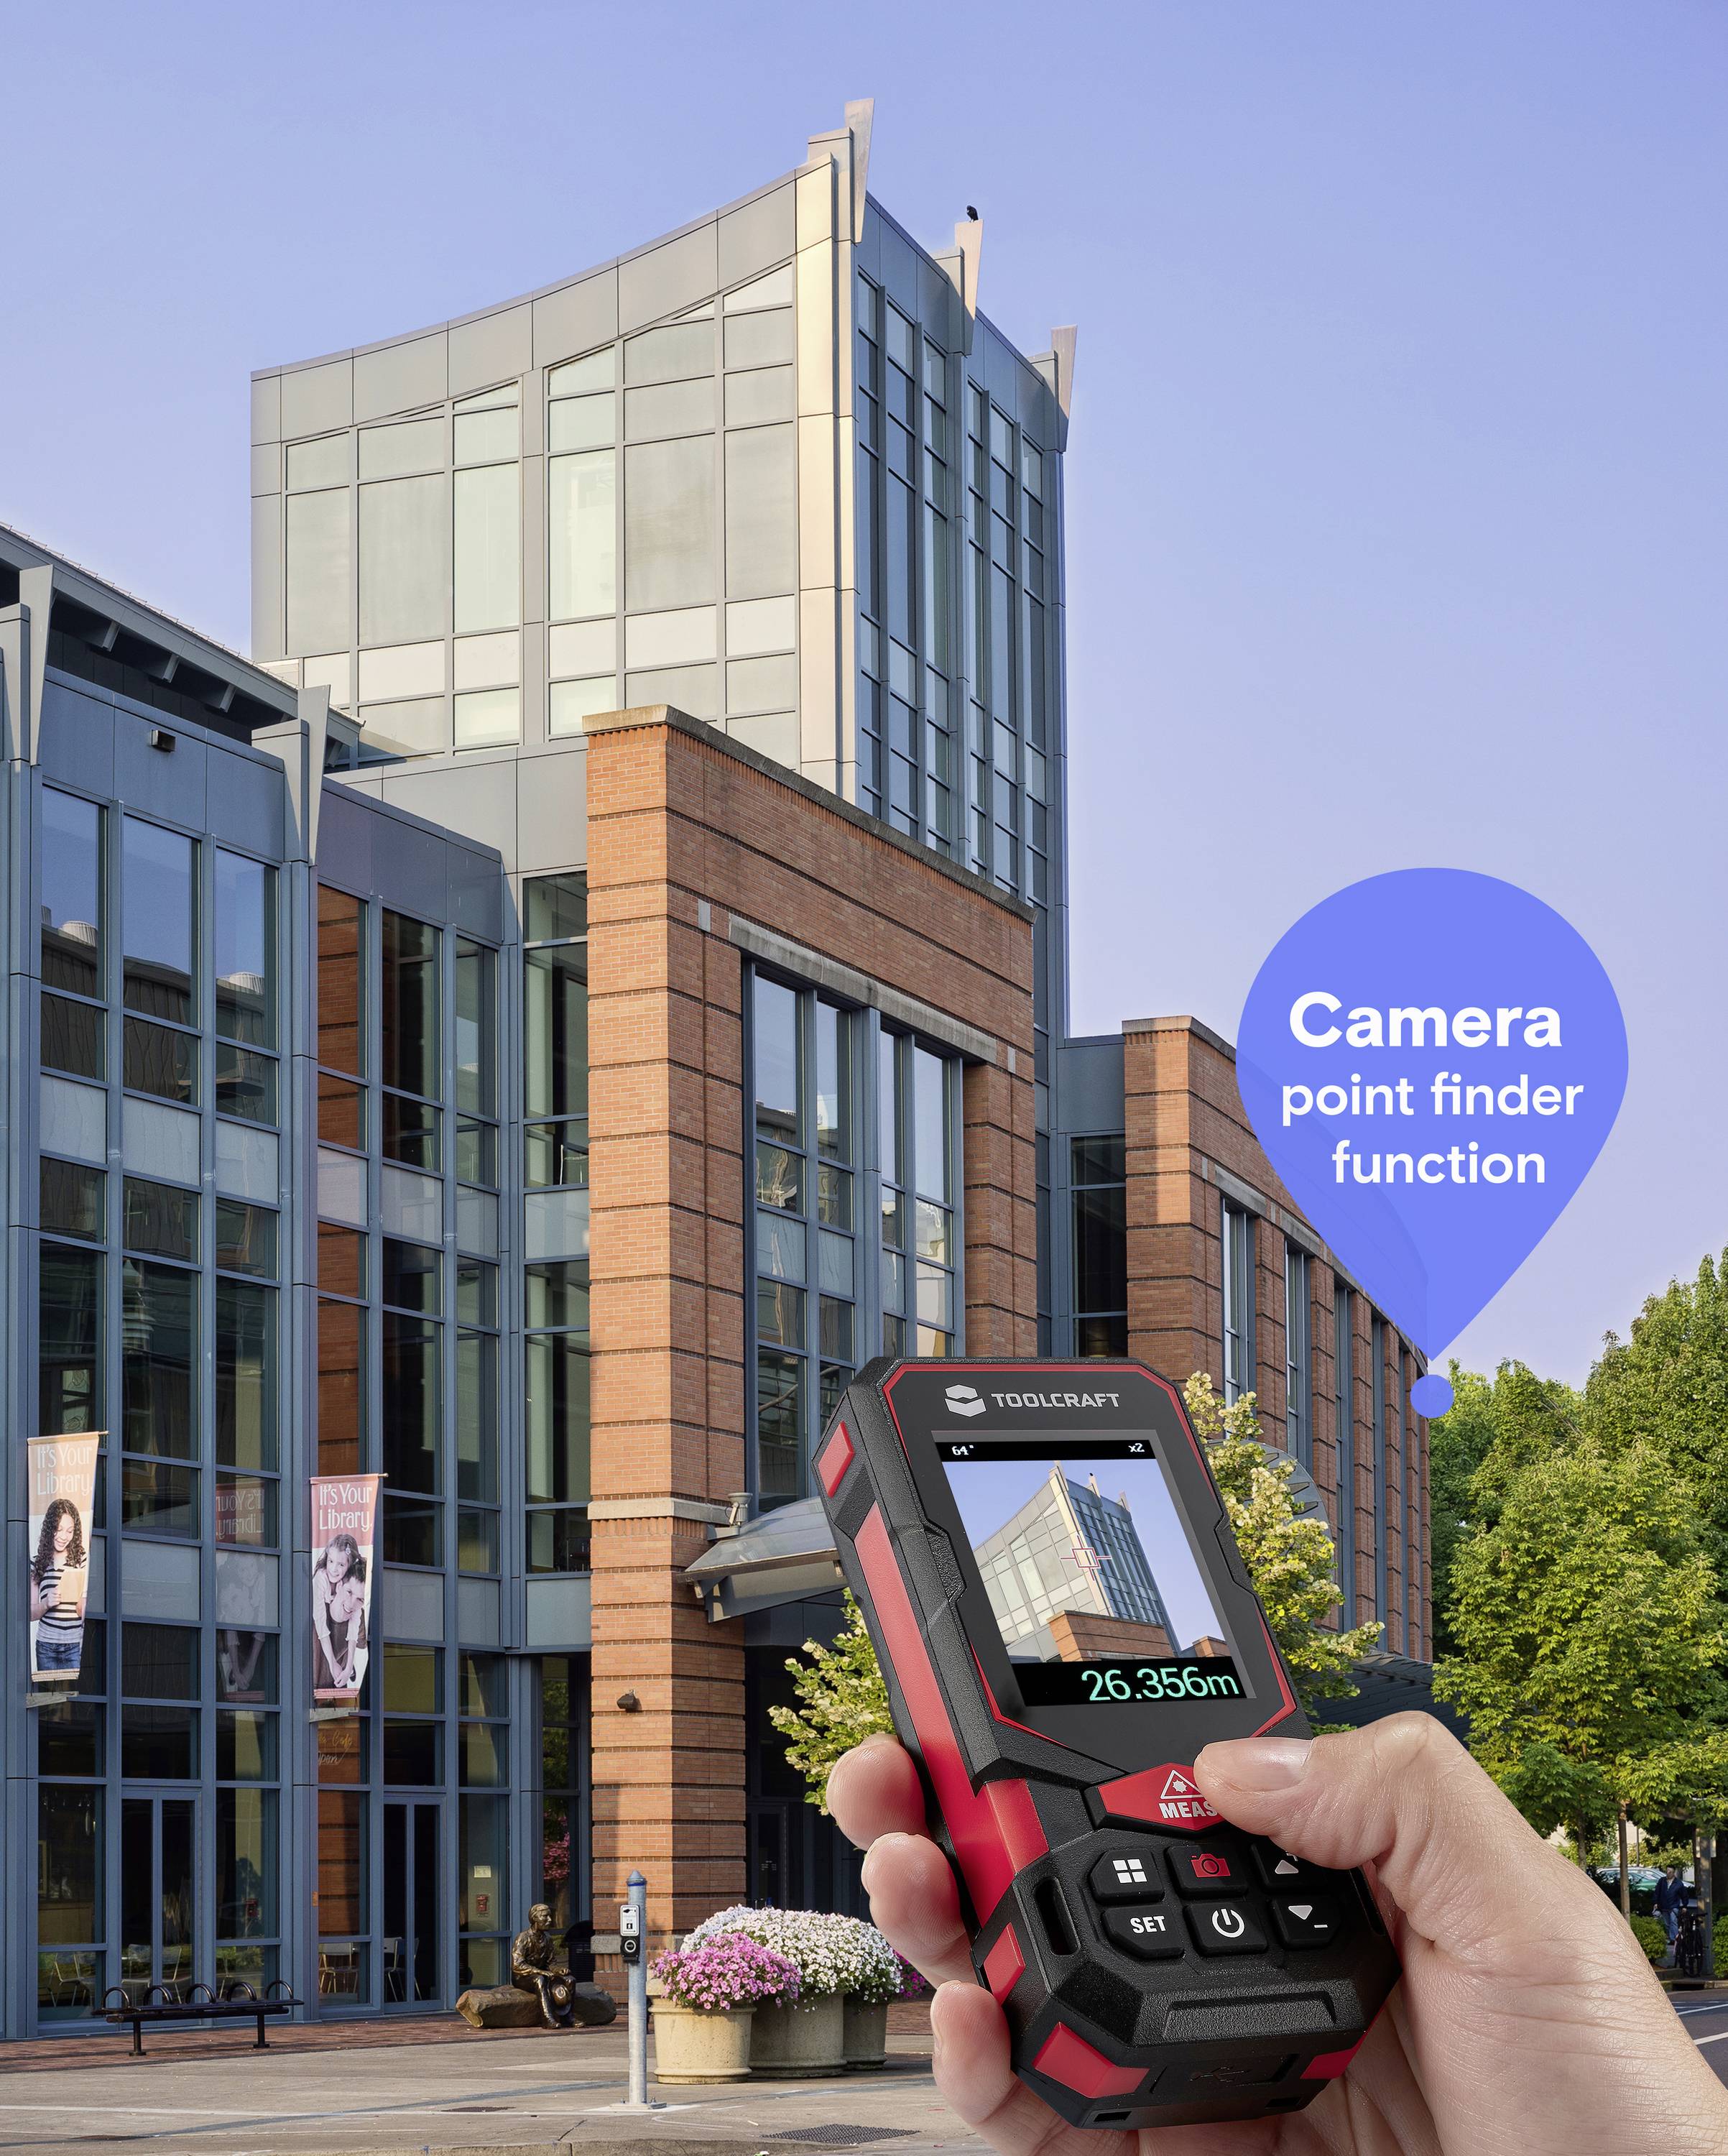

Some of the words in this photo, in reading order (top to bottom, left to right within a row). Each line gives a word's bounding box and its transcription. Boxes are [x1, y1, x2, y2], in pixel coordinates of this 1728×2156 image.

[991, 1393, 1119, 1407] TOOLCRAFT
[37, 1444, 57, 1469] It's
[57, 1444, 92, 1467] Your
[1129, 1443, 1145, 1452] x2
[320, 1484, 338, 1506] It's
[339, 1484, 372, 1504] Your
[1081, 1667, 1239, 1701] 26.356m
[1130, 1915, 1166, 1934] SET
